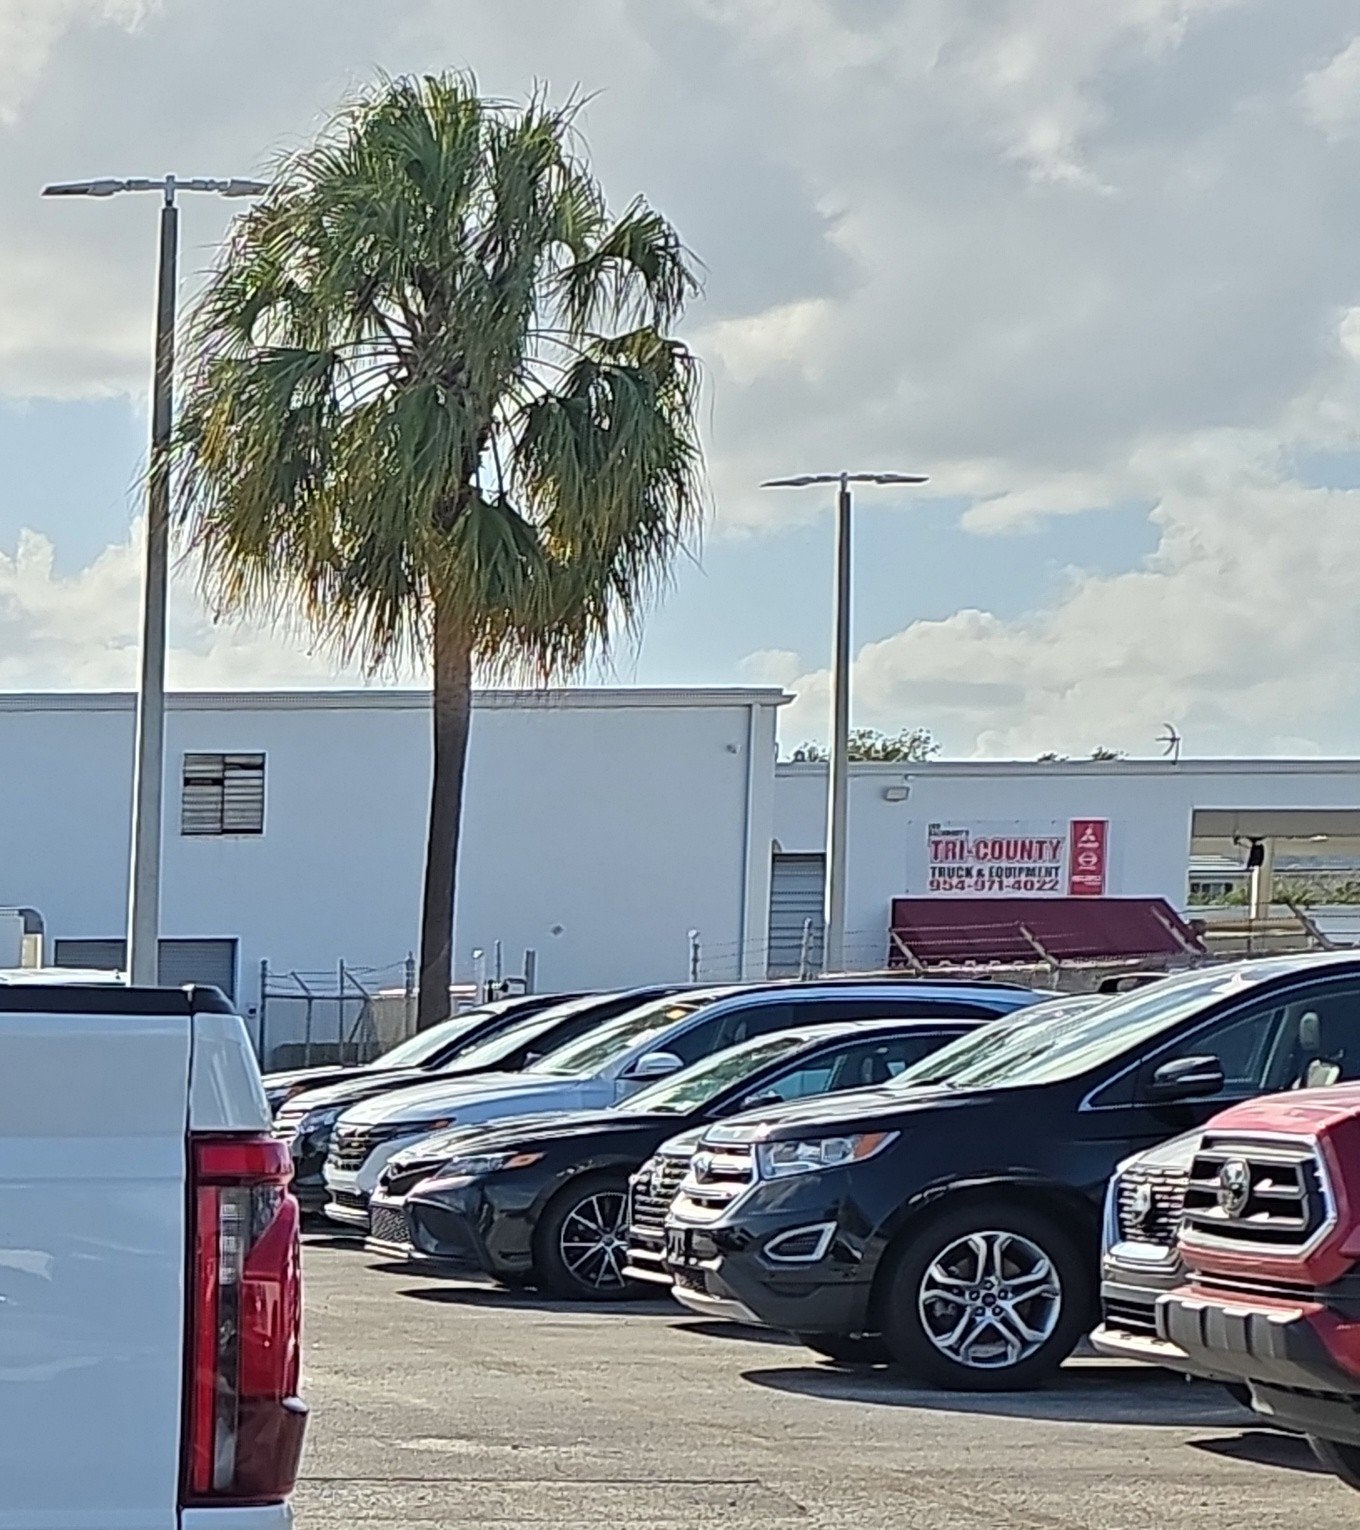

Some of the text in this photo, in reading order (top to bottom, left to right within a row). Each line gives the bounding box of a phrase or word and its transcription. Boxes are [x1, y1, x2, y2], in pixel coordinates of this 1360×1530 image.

[931, 839, 1062, 862] TRI-COUNTY
[930, 866, 974, 878] TRUCK
[988, 866, 1060, 878] EQUIPMENT
